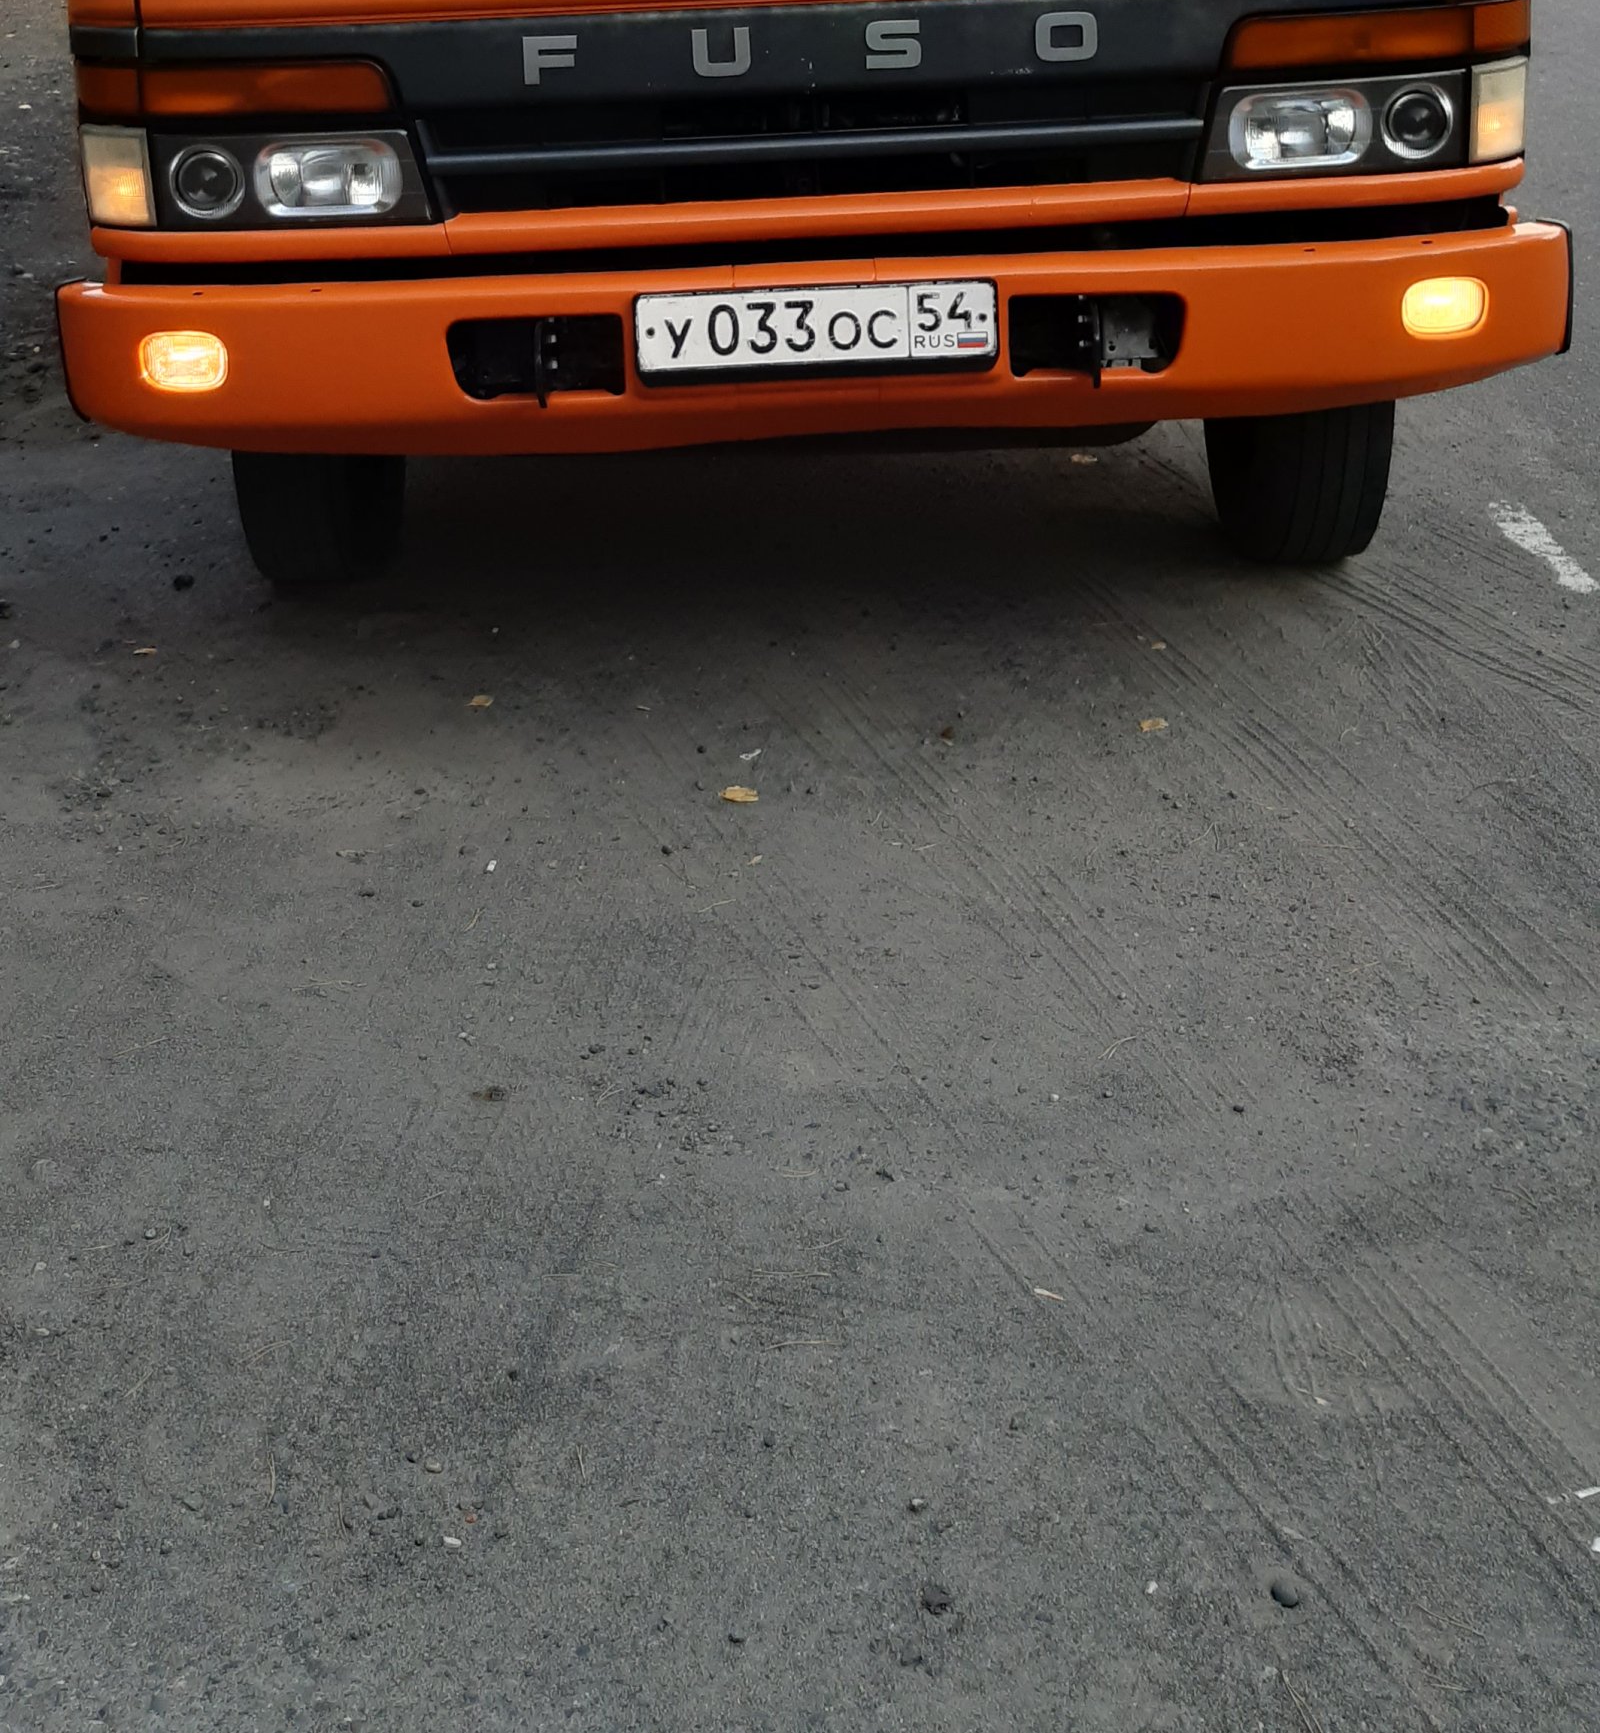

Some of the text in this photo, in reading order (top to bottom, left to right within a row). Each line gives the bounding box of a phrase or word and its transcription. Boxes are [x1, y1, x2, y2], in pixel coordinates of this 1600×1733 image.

[522, 10, 1098, 85] FUSO
[916, 291, 973, 332] 54
[914, 334, 955, 350] RUS
